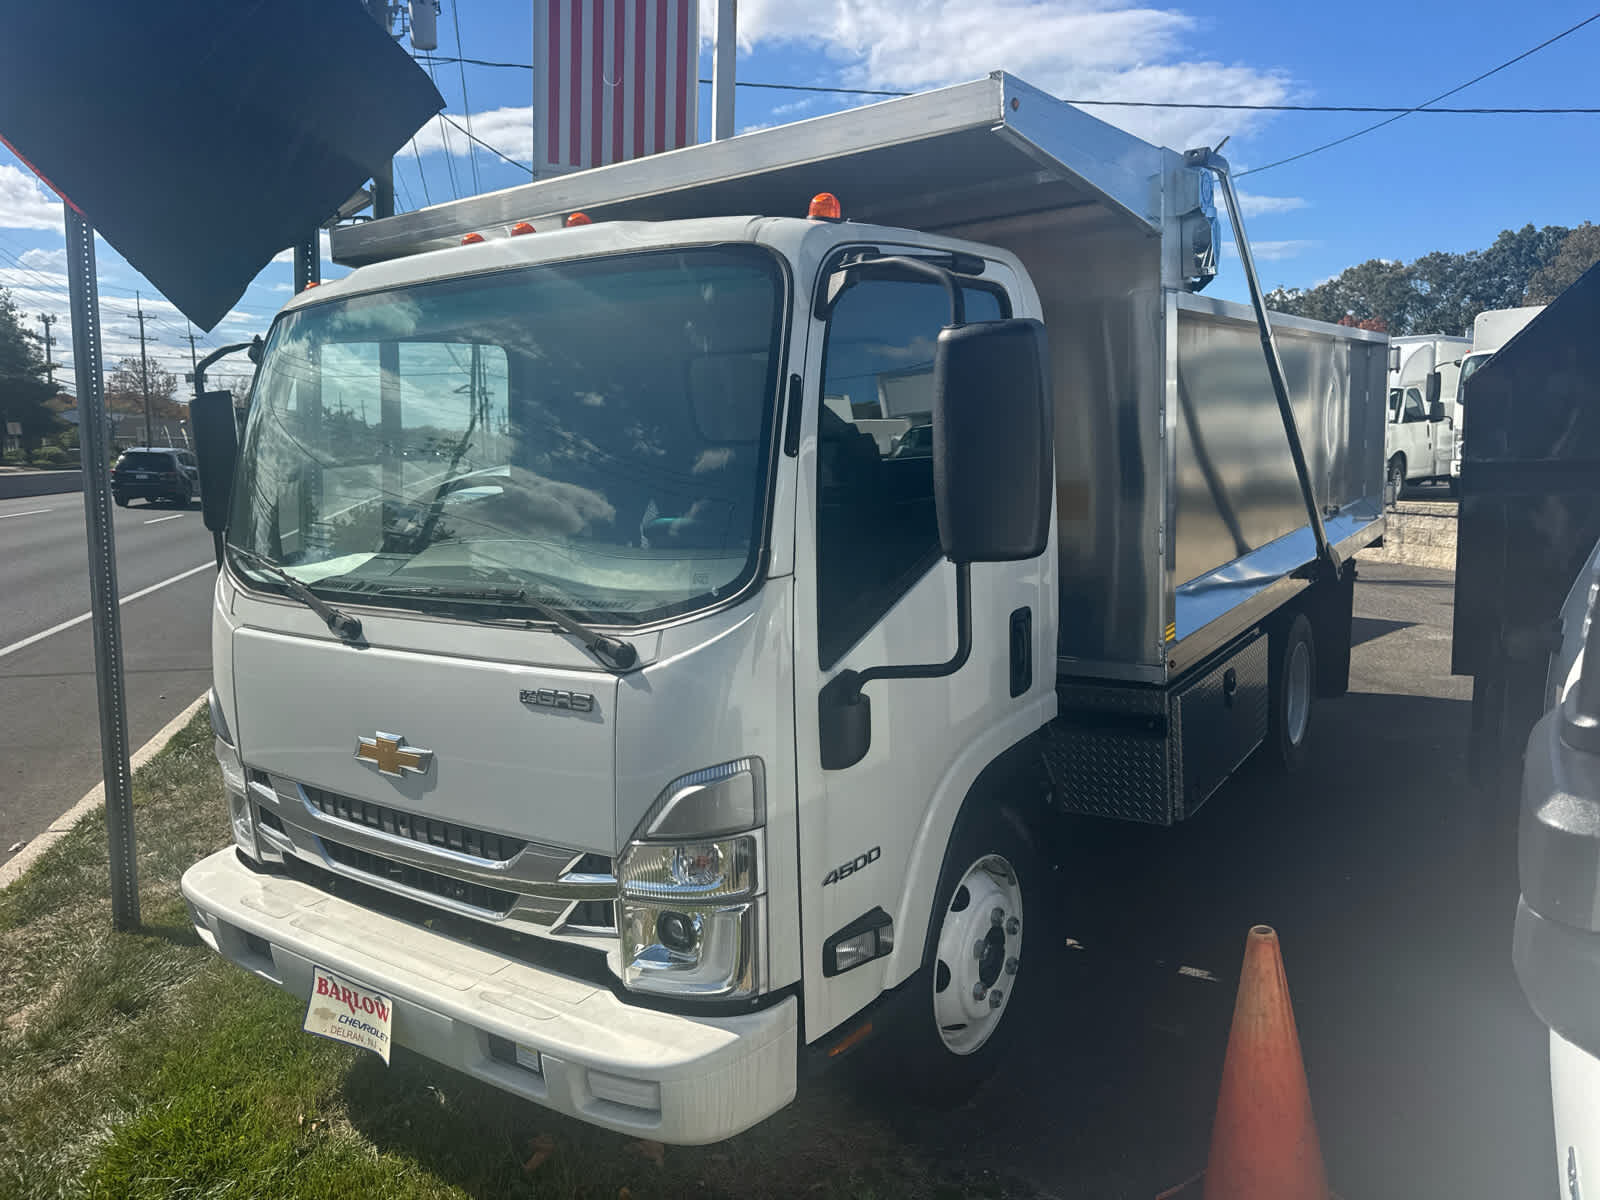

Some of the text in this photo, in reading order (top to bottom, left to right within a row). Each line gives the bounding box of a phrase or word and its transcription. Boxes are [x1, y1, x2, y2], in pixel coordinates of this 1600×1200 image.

[822, 845, 881, 887] 4500
[316, 976, 390, 1022] BARLOW
[338, 1014, 389, 1044] CHEVROLET
